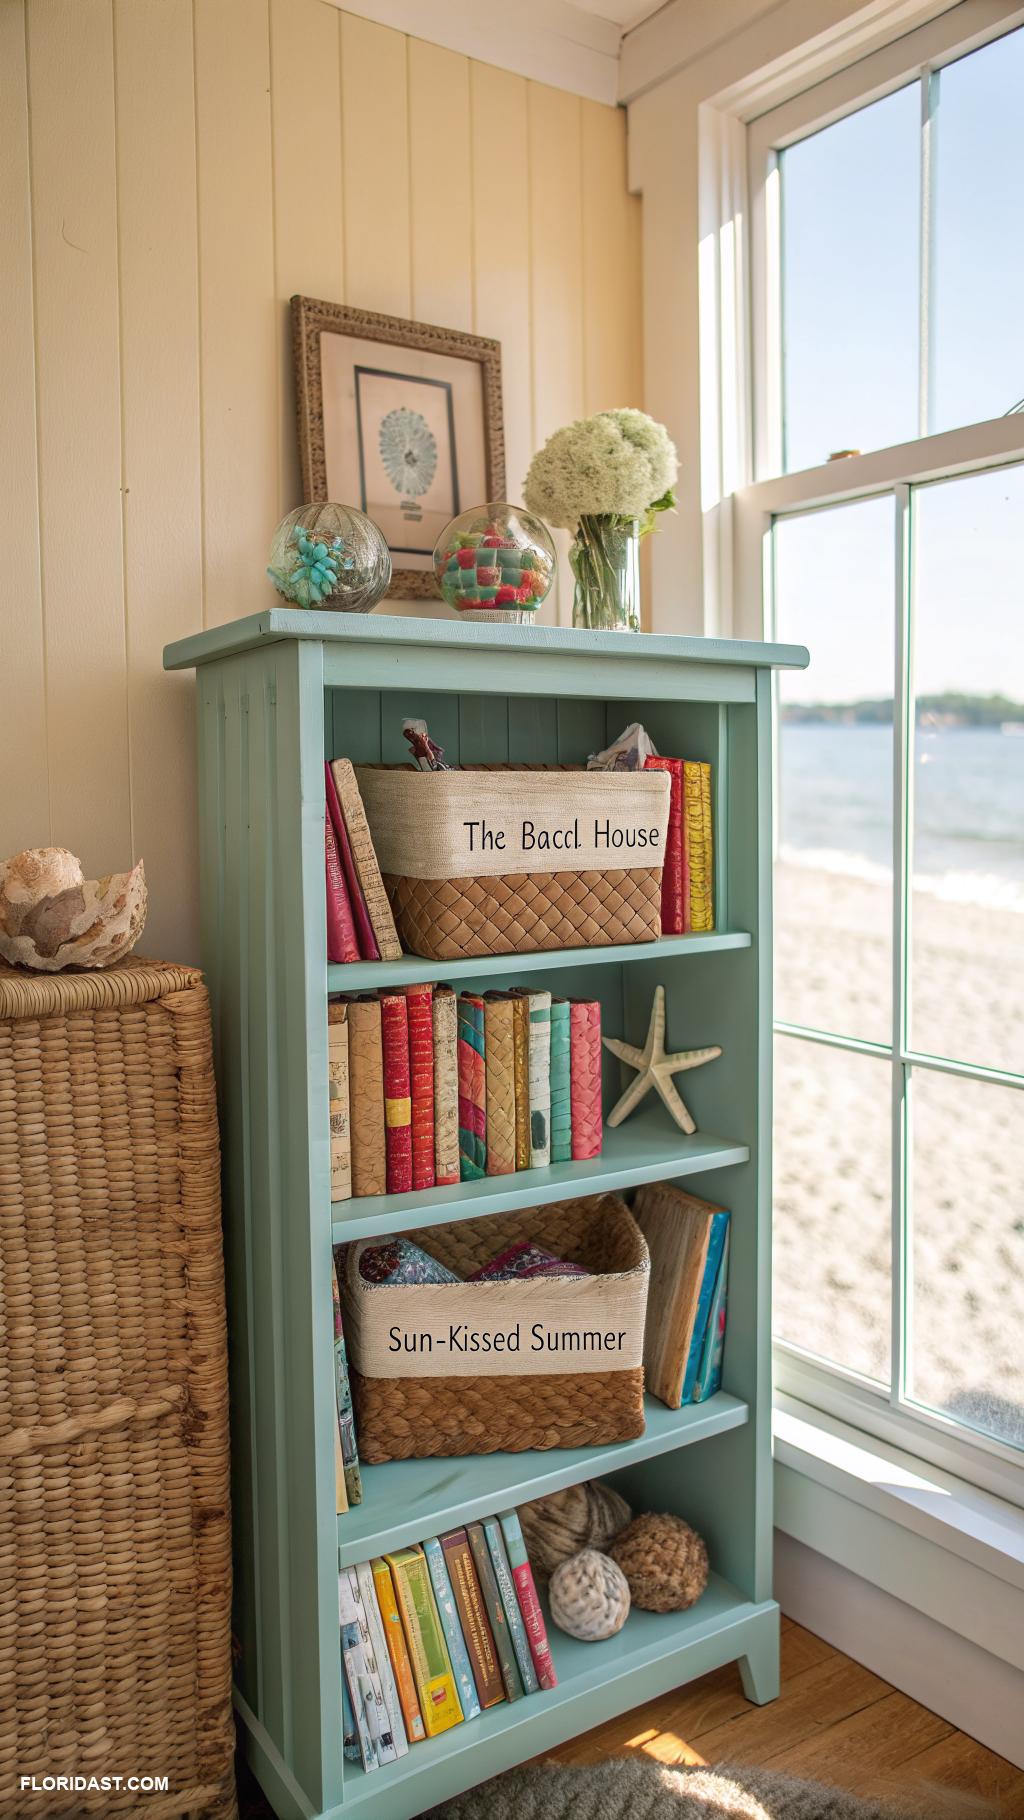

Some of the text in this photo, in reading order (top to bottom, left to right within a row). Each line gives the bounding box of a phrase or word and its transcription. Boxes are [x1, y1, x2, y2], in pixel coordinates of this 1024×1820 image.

[463, 821, 506, 852] The
[594, 819, 660, 849] House
[388, 1323, 627, 1352] Sun-Kissed Summer
